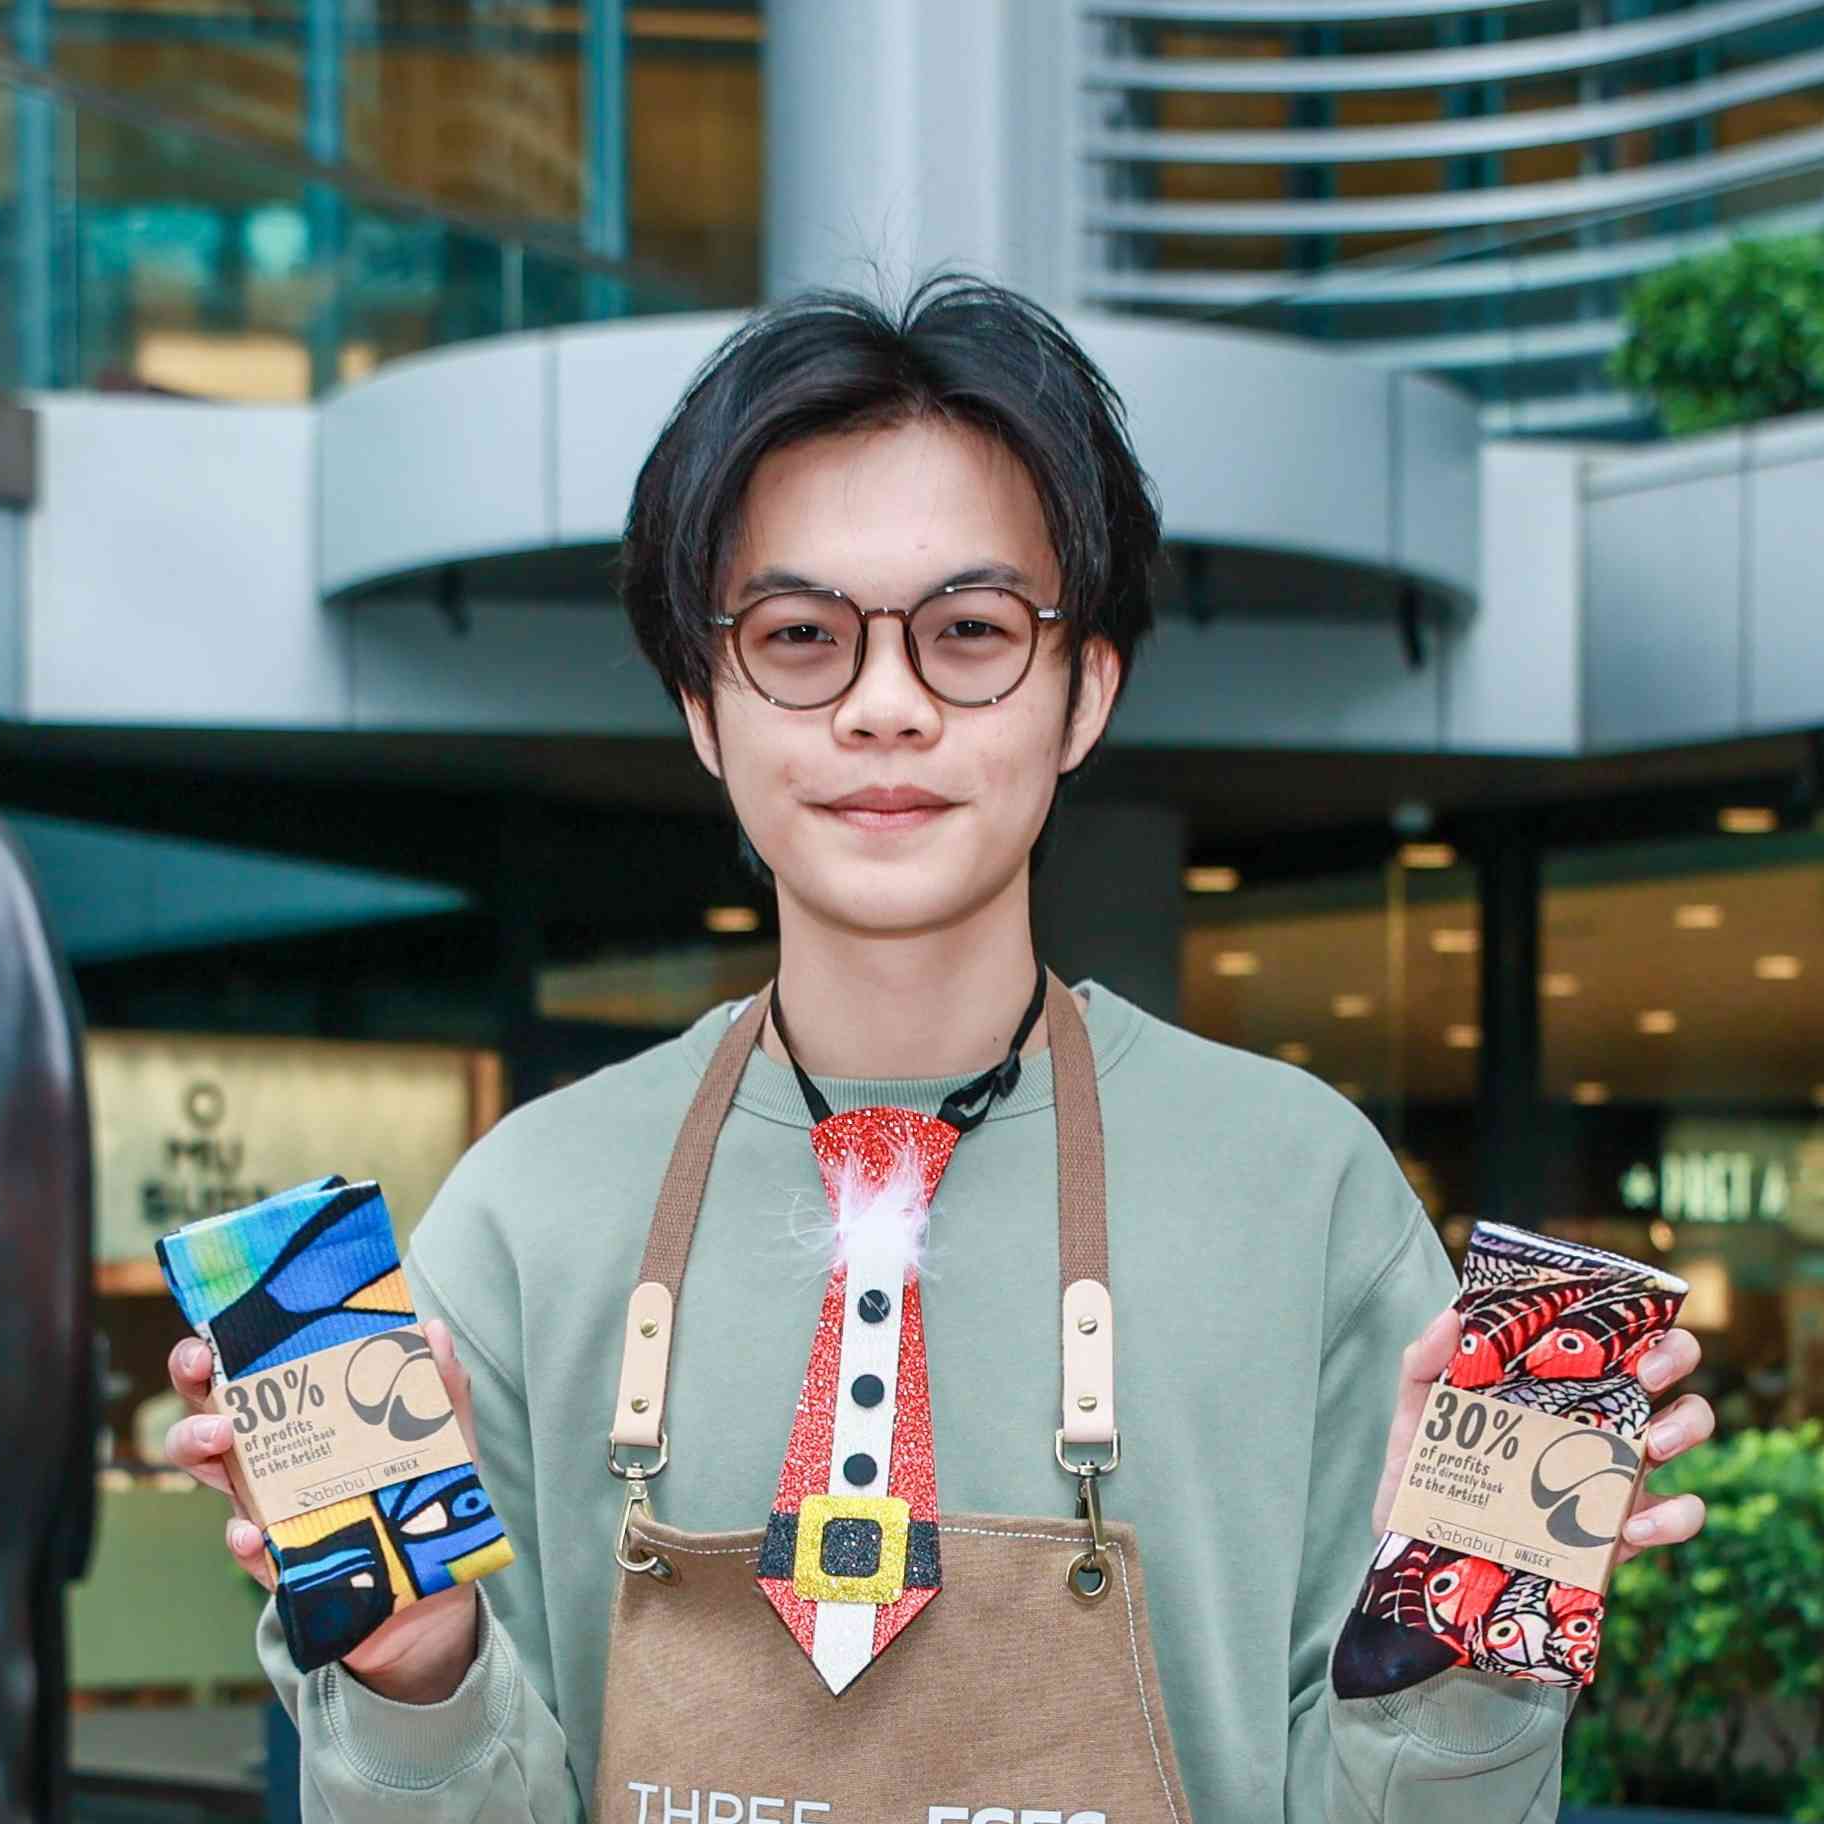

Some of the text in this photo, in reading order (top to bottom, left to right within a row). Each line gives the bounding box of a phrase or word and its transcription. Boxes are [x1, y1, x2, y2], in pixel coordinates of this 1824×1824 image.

[224, 1363, 325, 1434] 30%
[244, 1420, 314, 1451] of profits
[313, 1427, 337, 1442] back
[1425, 1390, 1523, 1460] 30%
[252, 1443, 333, 1480] to the Artist!
[1420, 1446, 1491, 1476] of profits
[1409, 1473, 1490, 1507] to the Artist!
[1480, 1478, 1504, 1494] back
